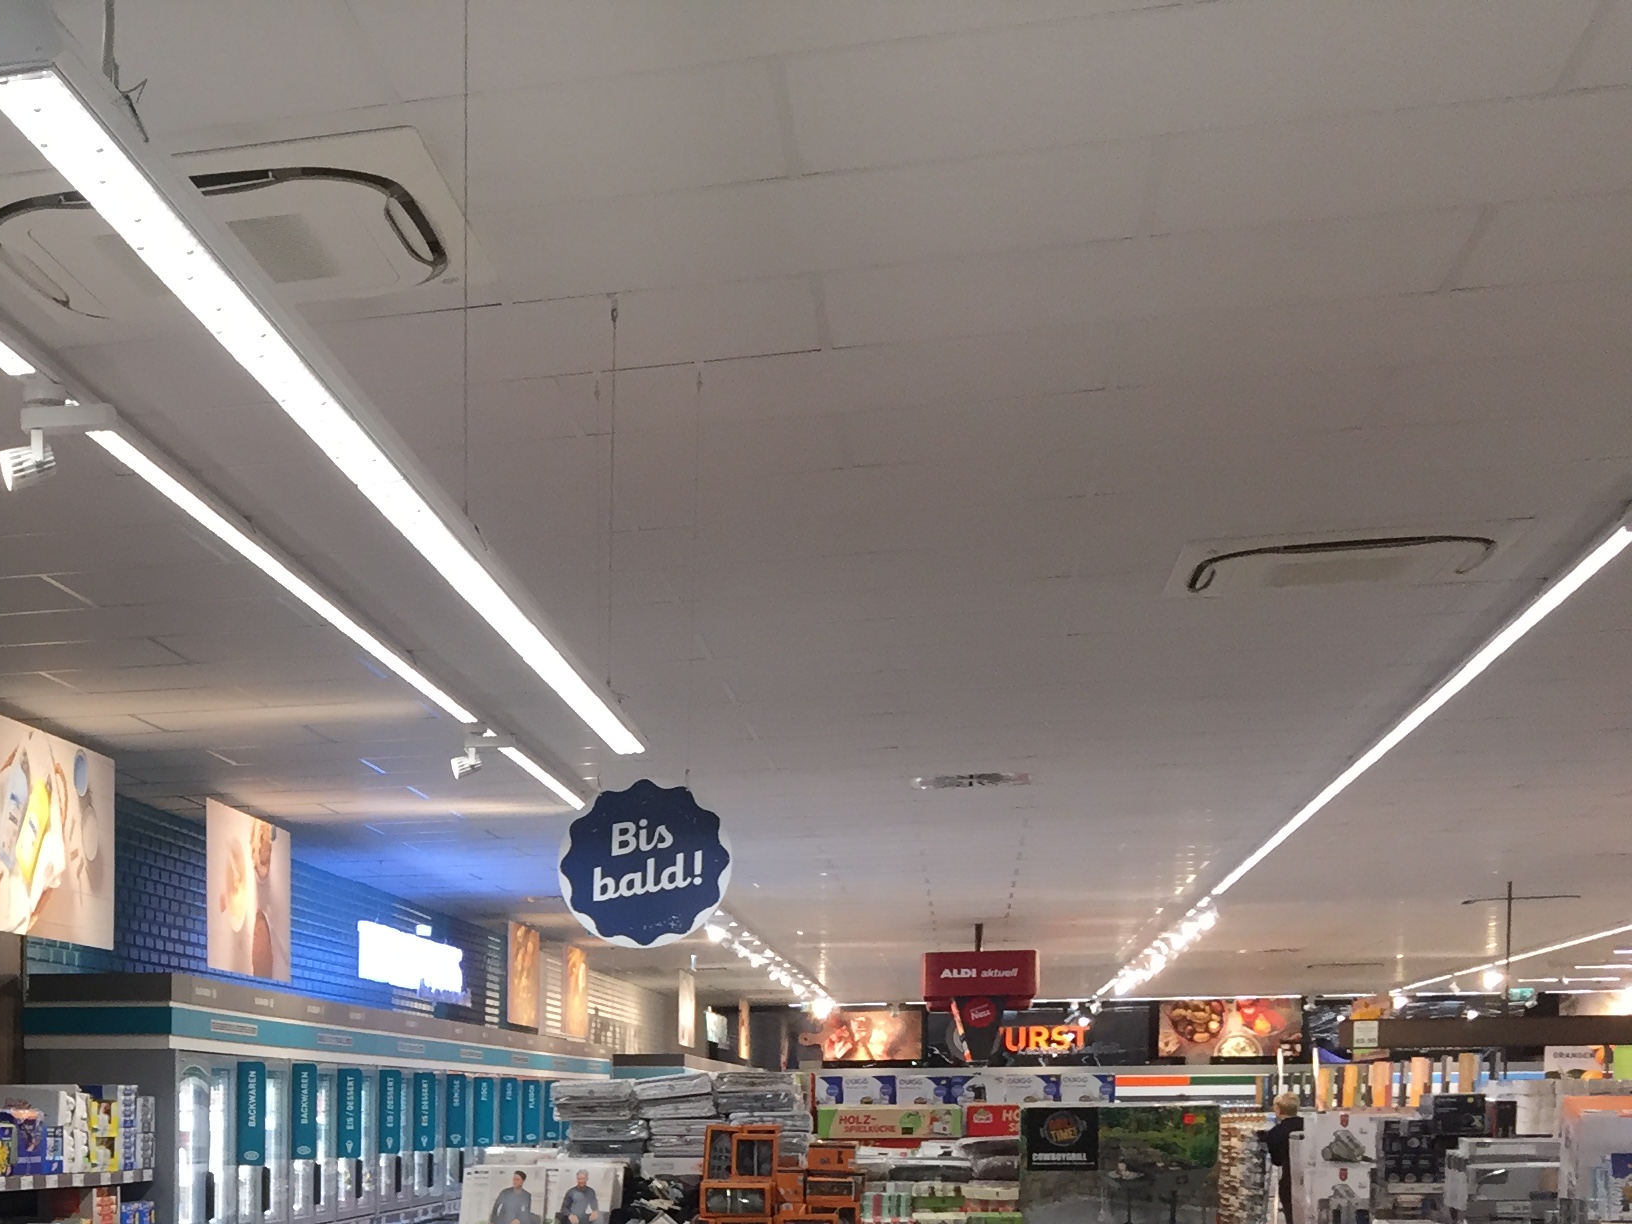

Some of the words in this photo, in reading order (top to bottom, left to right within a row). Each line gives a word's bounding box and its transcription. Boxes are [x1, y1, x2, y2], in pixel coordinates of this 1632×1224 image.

[611, 818, 674, 856] Bis
[592, 850, 703, 902] bald!
[940, 968, 977, 979] ALDI
[999, 1025, 1090, 1052] URST
[248, 1070, 257, 1128] BACKWAREN
